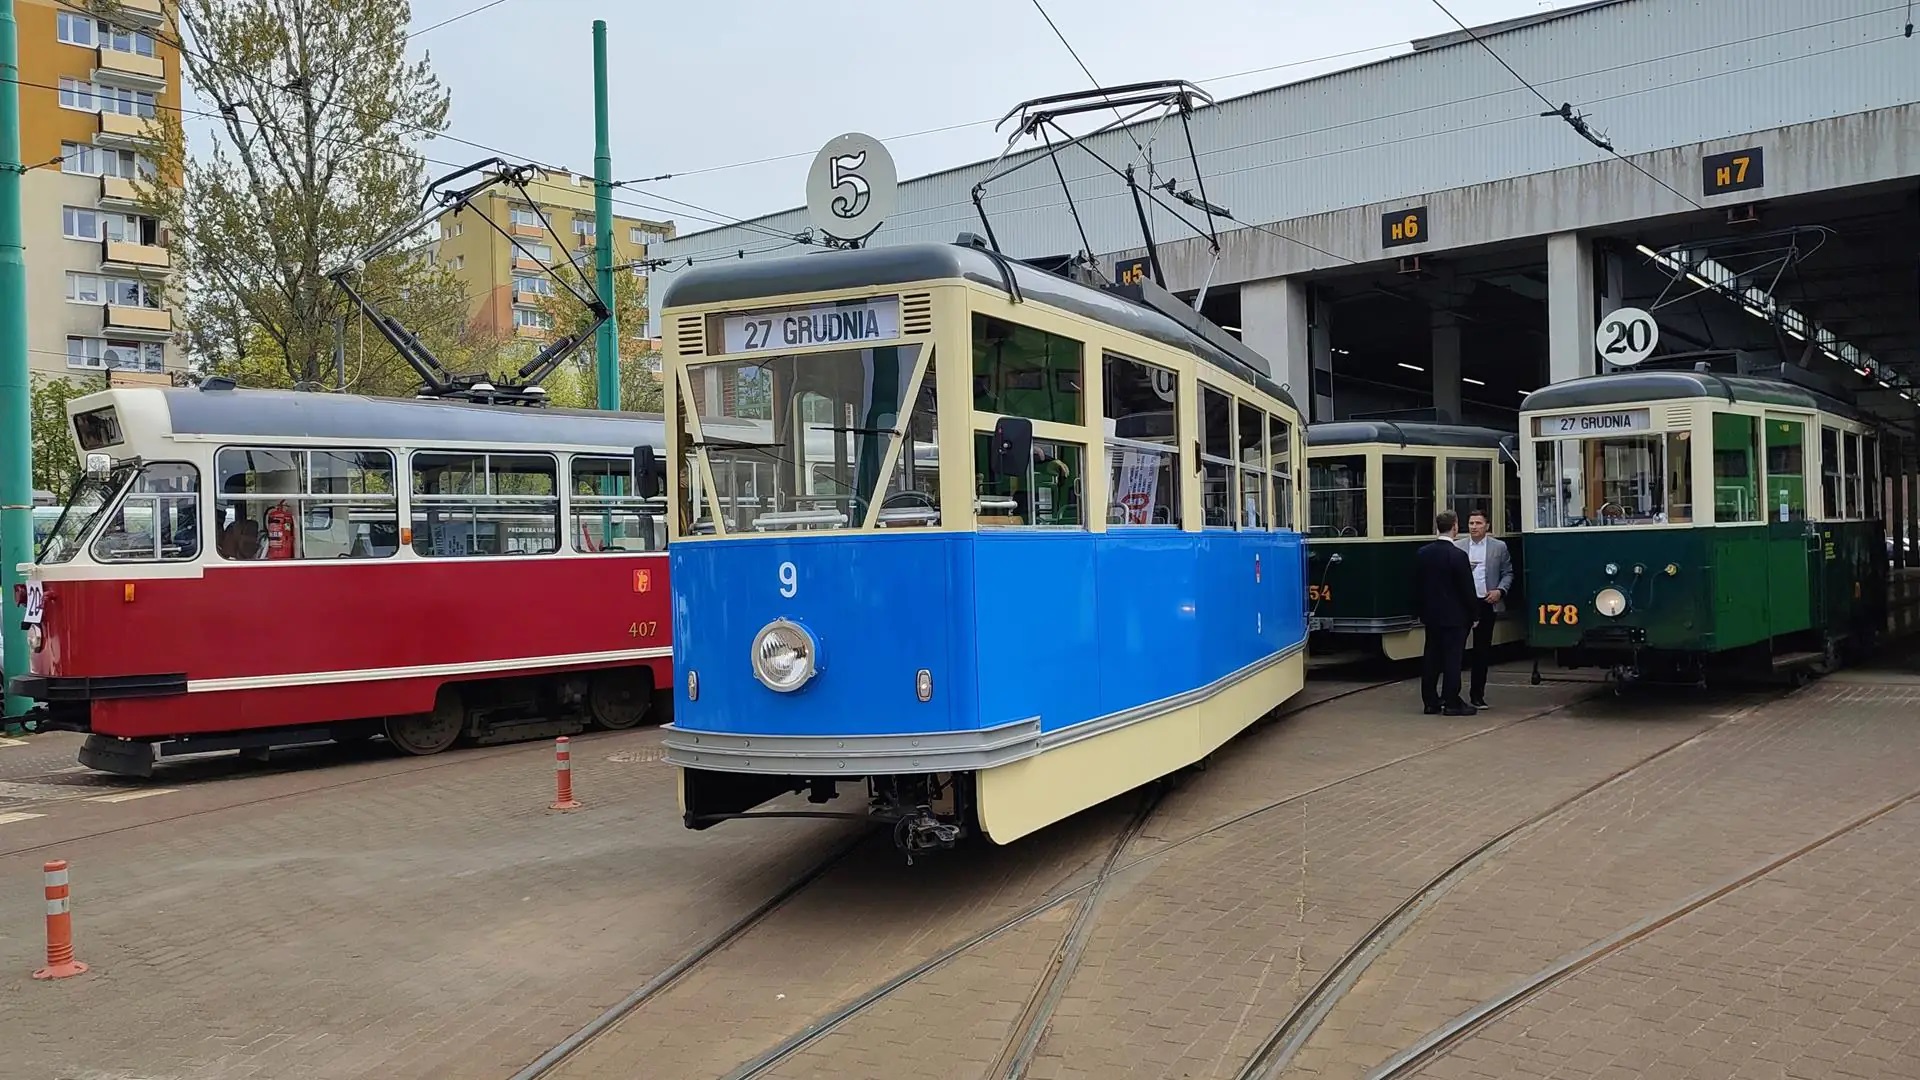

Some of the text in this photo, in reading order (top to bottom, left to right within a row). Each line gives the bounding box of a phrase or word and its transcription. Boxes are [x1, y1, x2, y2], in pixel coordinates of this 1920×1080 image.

[830, 150, 871, 218] 5
[1716, 157, 1750, 186] H7
[1391, 215, 1418, 240] H6
[1122, 263, 1143, 286] H5
[744, 309, 880, 350] 27 GRUDNIA
[1605, 318, 1652, 355] 20
[1560, 414, 1632, 431] 27 GRUDNIA
[779, 561, 797, 598] 9
[28, 586, 42, 617] 20
[1538, 604, 1579, 625] 178
[628, 621, 657, 637] 407
